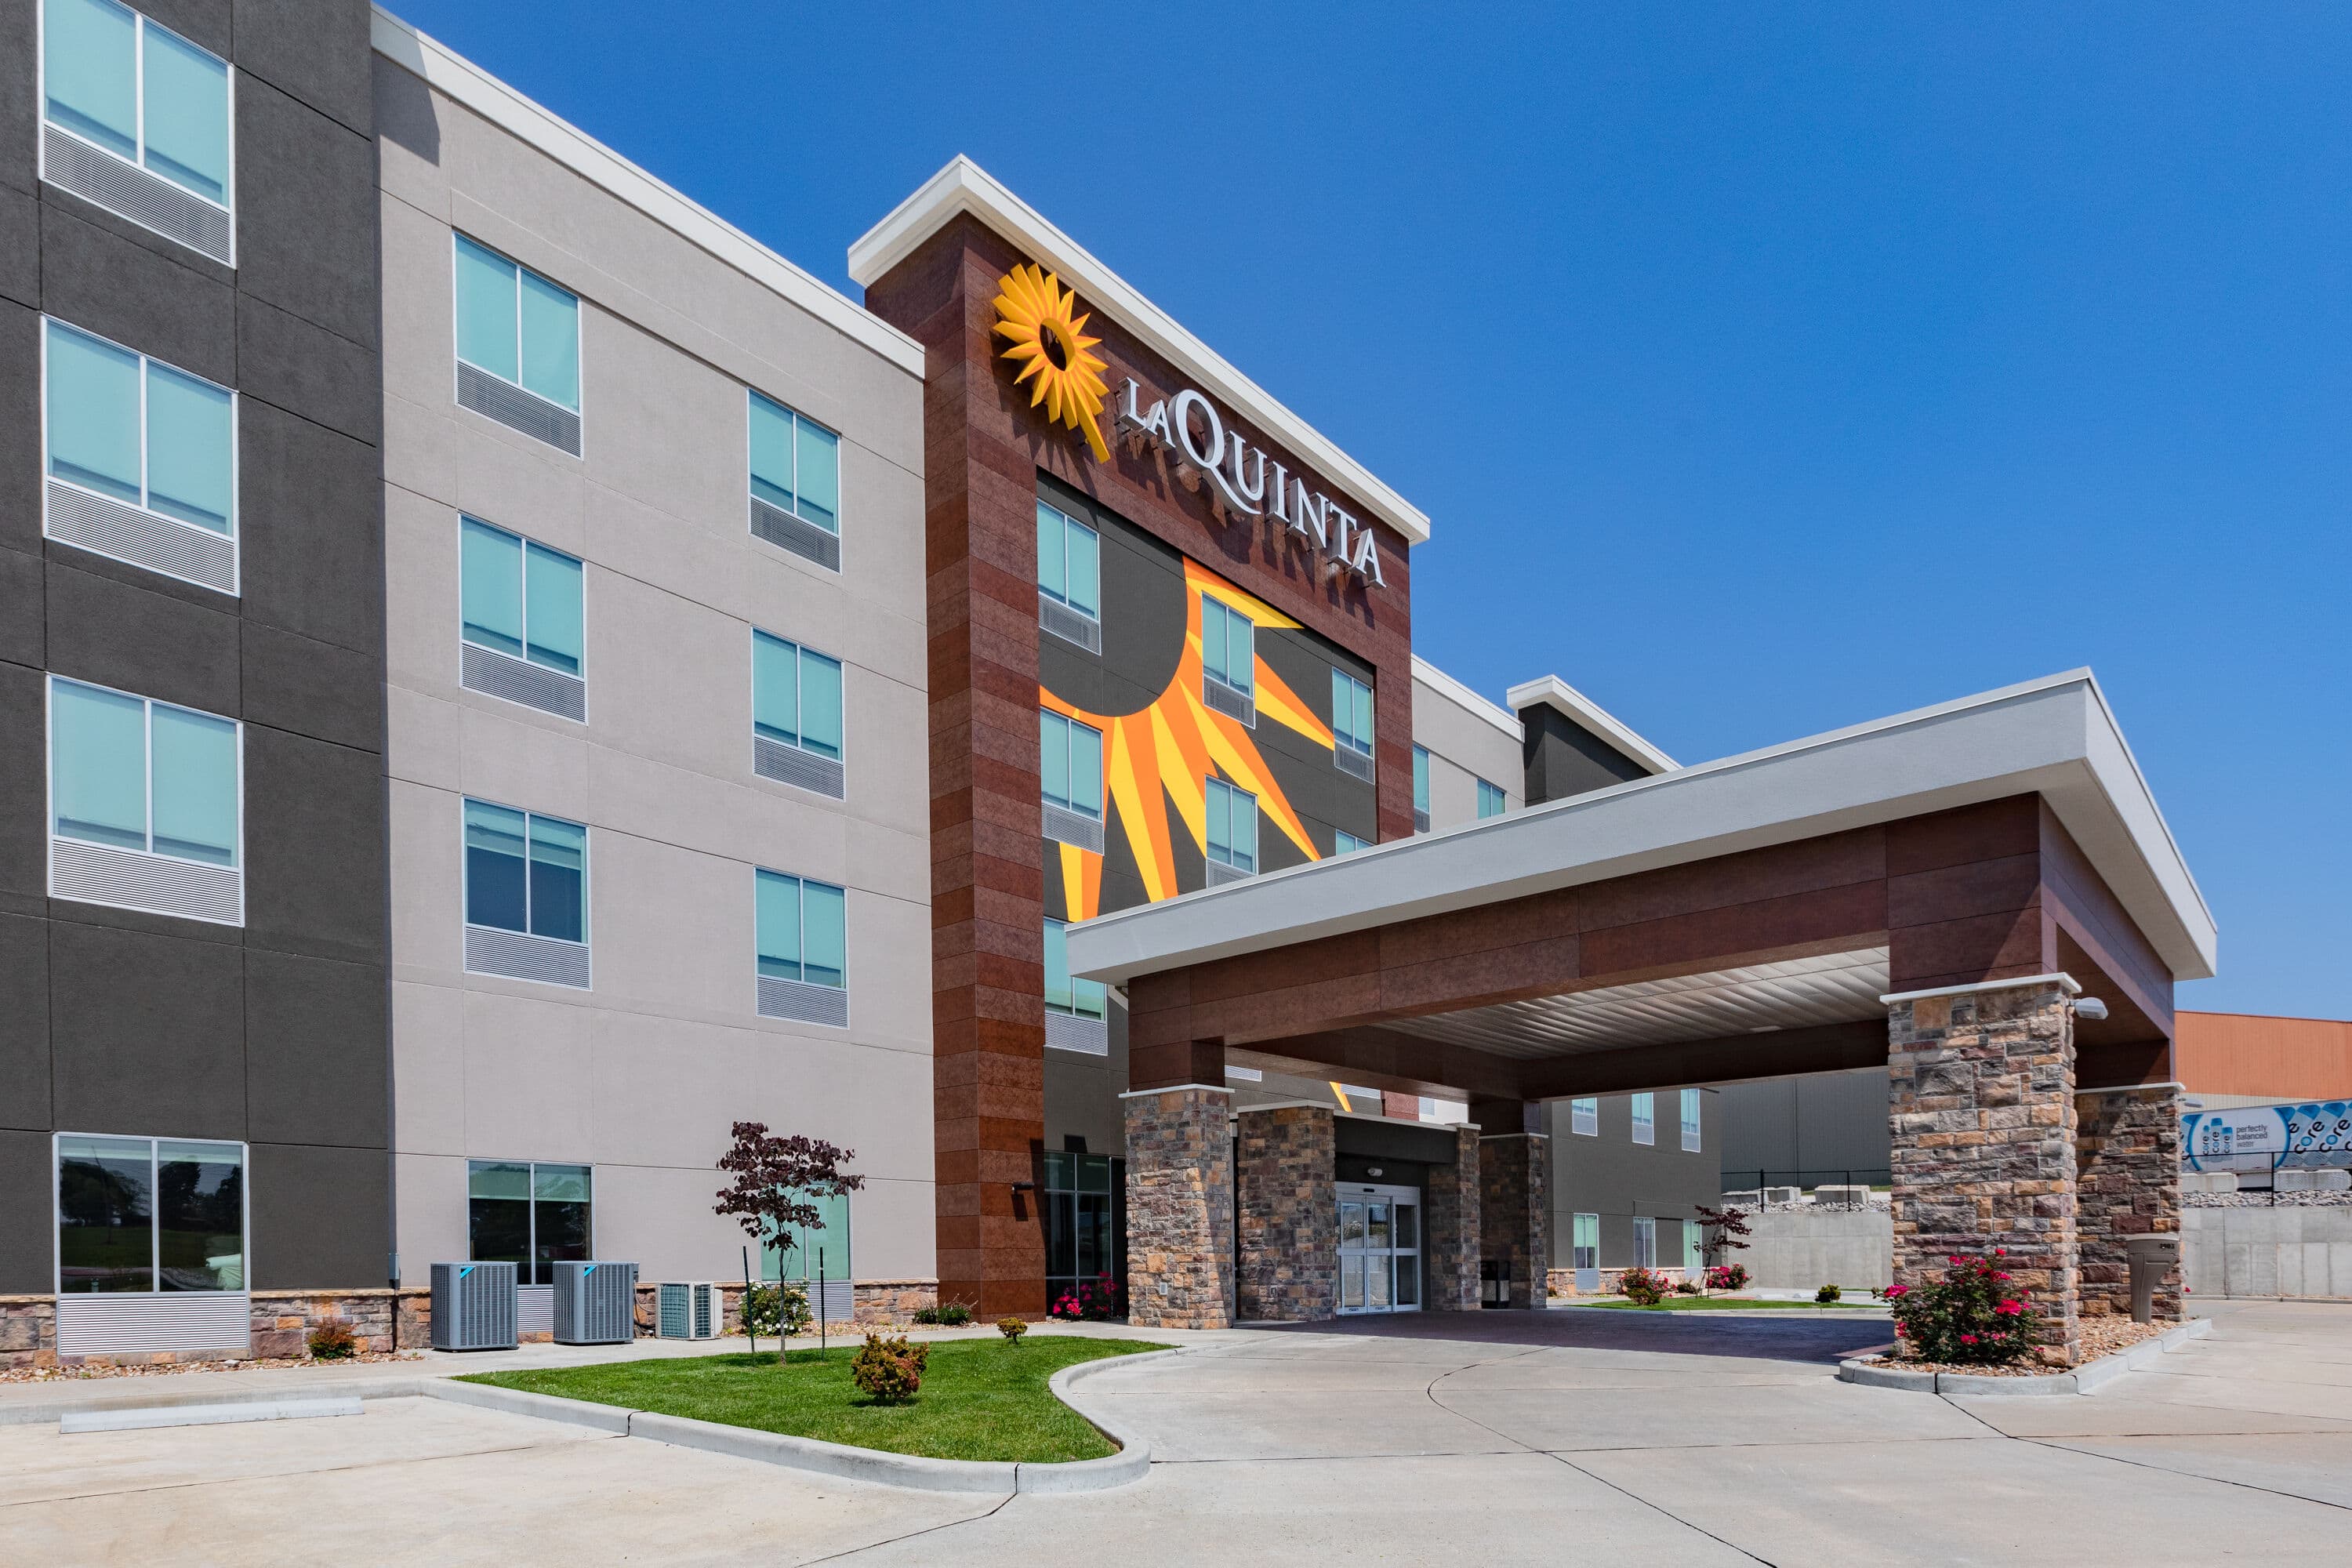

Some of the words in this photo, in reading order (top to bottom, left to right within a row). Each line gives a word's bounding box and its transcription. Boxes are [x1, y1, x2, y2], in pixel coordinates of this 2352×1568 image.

[2236, 1124, 2267, 1133] perfectly
[2294, 1121, 2325, 1154] core
[2319, 1119, 2350, 1152] core
